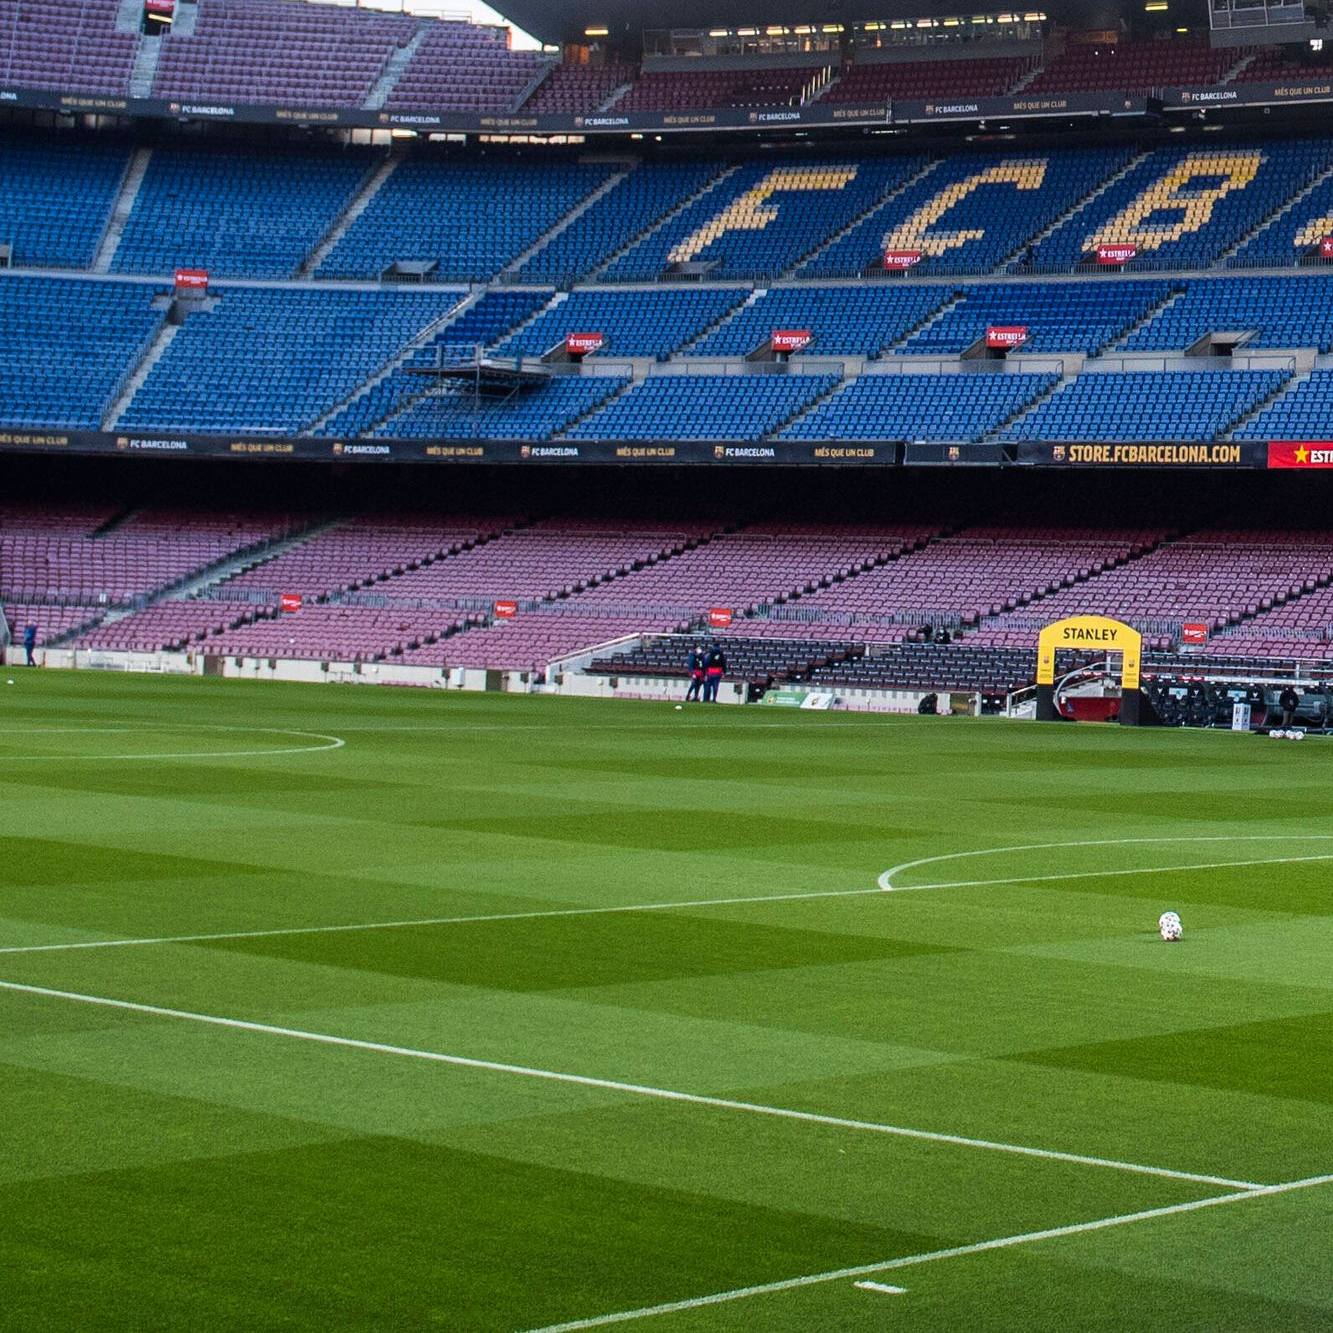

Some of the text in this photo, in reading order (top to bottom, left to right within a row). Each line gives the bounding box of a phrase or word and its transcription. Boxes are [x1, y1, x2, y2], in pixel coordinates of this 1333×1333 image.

[1200, 91, 1236, 100] BARCELONA
[1290, 87, 1302, 97] QUE
[1314, 87, 1330, 96] CLUB
[665, 164, 1048, 263] FC
[541, 447, 578, 457] BARCELONA
[633, 446, 645, 456] QUE
[658, 446, 675, 456] CLUB
[735, 447, 774, 457] BARCELONA
[831, 447, 844, 457] QUE
[857, 447, 874, 457] CLUB
[1069, 446, 1240, 463] STORE.FCBARCELONA.COM
[1063, 628, 1117, 641] STANLEY
